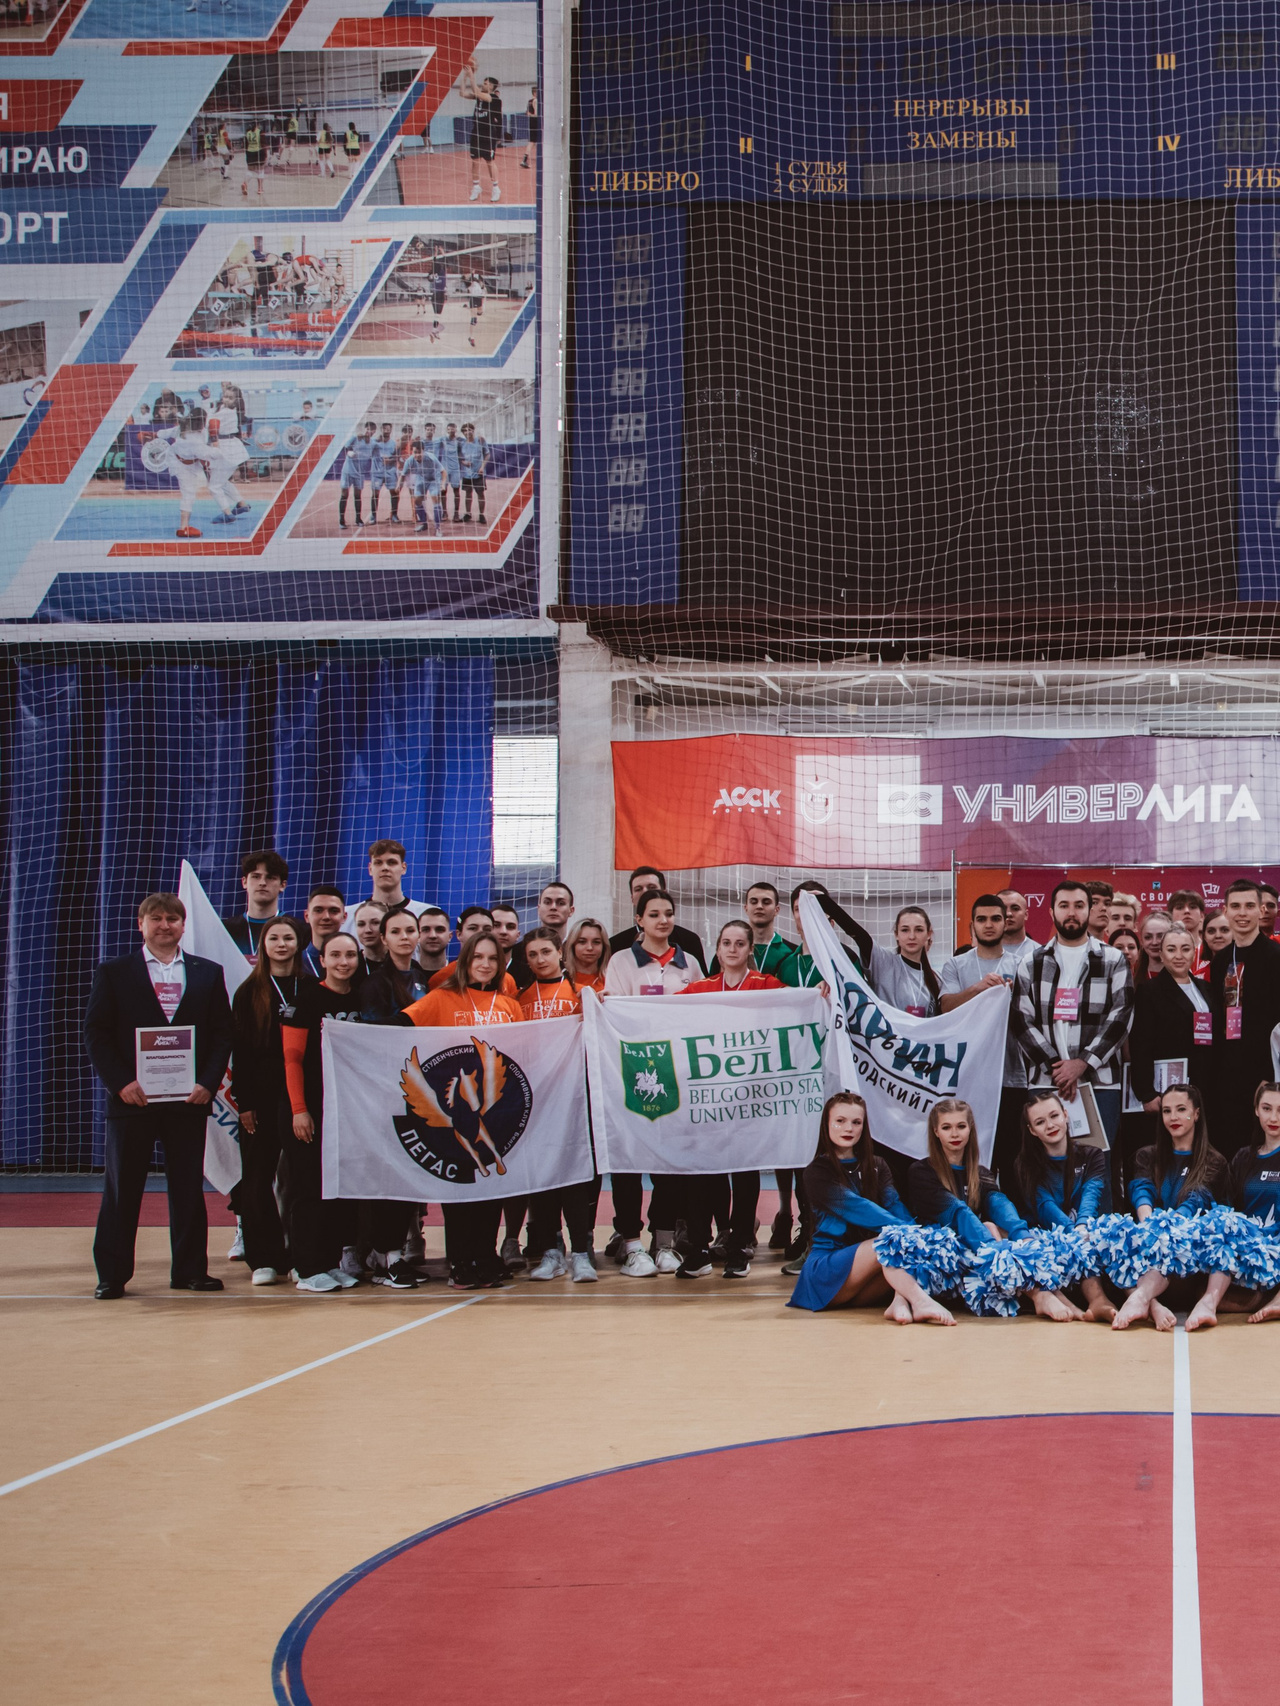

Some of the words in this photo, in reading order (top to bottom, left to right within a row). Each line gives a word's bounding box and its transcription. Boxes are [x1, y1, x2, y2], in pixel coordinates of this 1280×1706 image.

[893, 99, 1030, 117] ПЕРЕРЫВЫ
[907, 131, 1016, 149] ЗАМЕНЫ
[1157, 135, 1181, 151] IV
[788, 161, 848, 177] СУДЬЯ
[590, 171, 700, 191] ЛИБЕРО
[788, 178, 848, 194] СУДЬЯ
[713, 786, 782, 809] АССК
[952, 782, 1262, 824] УНИВЕРЛИГА
[723, 1028, 770, 1048] НИУ
[623, 1043, 667, 1058] БелГУ
[421, 1046, 475, 1073] СТУДЕНЧЕСКИЙ
[508, 1063, 532, 1108] СПОРТИВНЫЙ
[689, 1080, 794, 1105] BELGOROD
[798, 1077, 822, 1095] STA
[689, 1099, 801, 1124] UNIVERSITY
[804, 1096, 823, 1116] (BS
[401, 1129, 458, 1179] ПЕГАС
